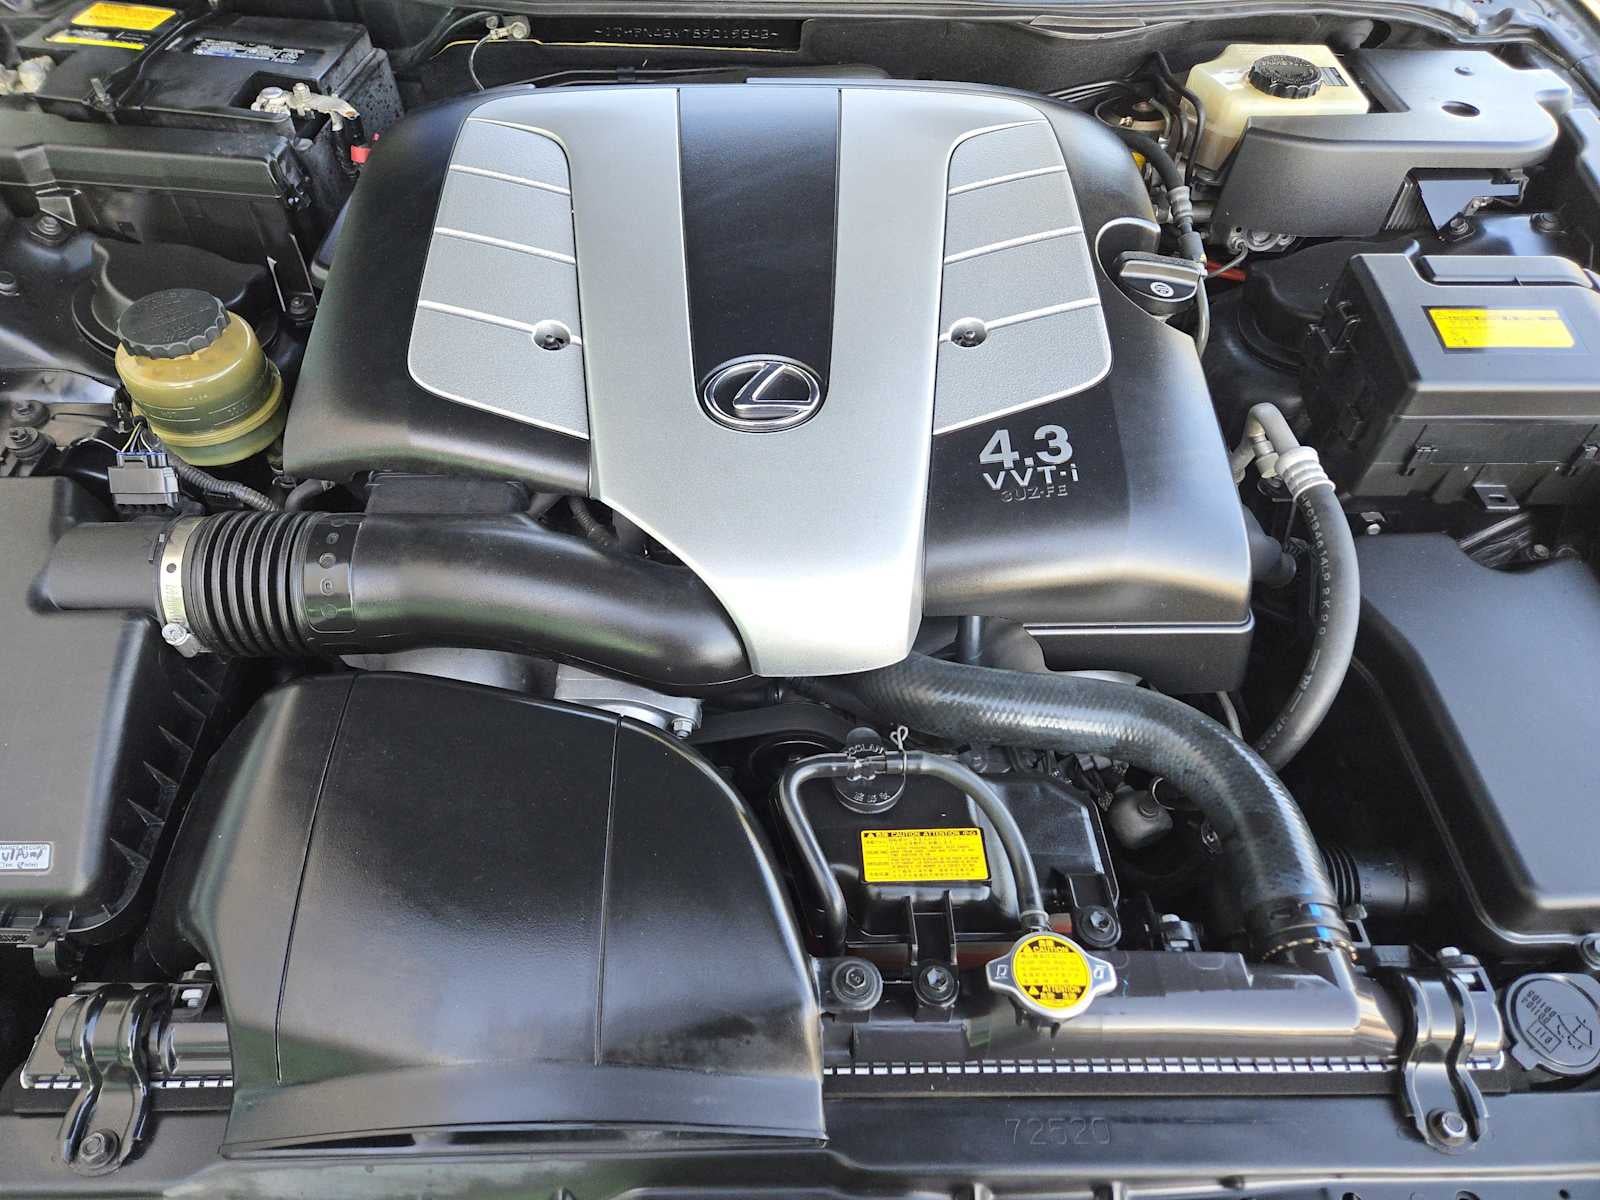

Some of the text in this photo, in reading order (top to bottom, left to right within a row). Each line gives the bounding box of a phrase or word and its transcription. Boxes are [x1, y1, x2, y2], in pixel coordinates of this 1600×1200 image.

[979, 424, 1073, 470] 4.3
[982, 463, 1079, 491] VVT-i
[1004, 1117, 1111, 1145] 72520
